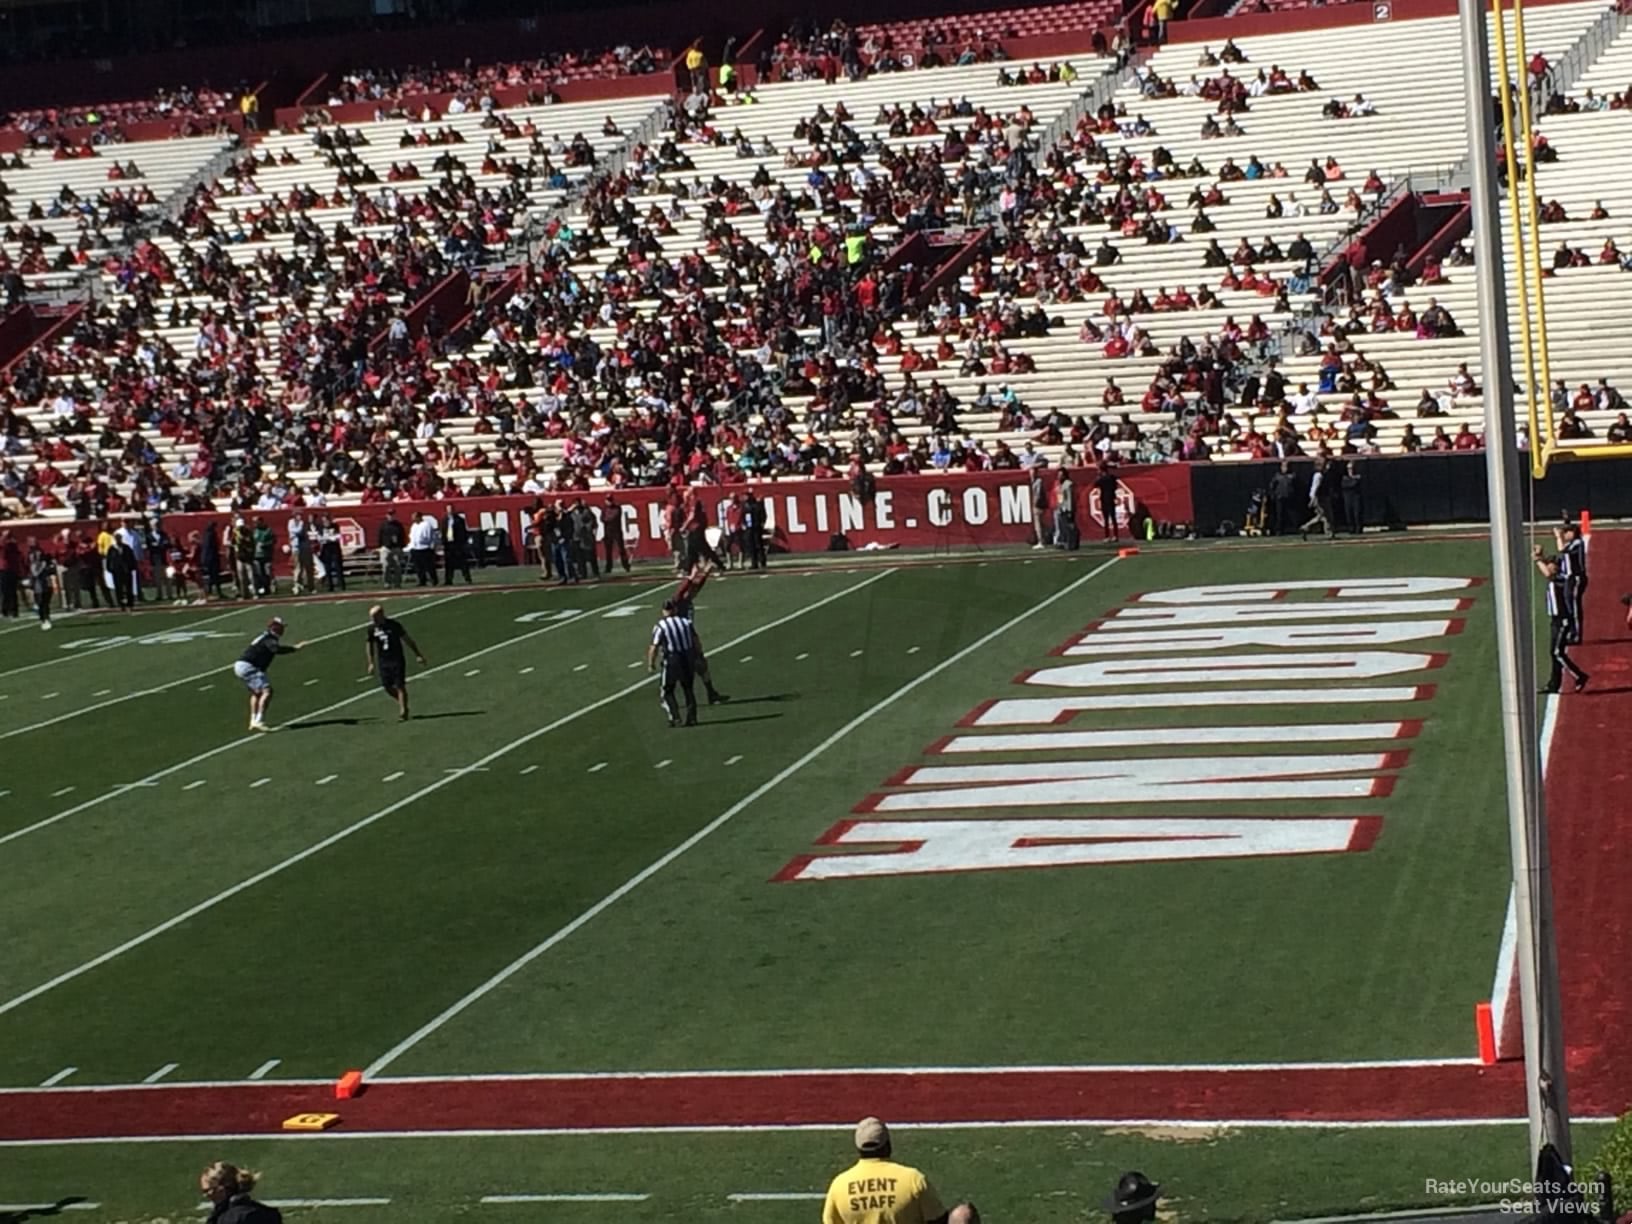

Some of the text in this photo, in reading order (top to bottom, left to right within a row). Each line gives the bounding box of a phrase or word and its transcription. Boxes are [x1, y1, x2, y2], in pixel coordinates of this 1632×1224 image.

[1376, 5, 1389, 19] 2
[902, 55, 914, 67] 3
[769, 575, 1487, 883] CAROLINA
[848, 1178, 898, 1195] EVENT
[850, 1195, 897, 1211] STAFF
